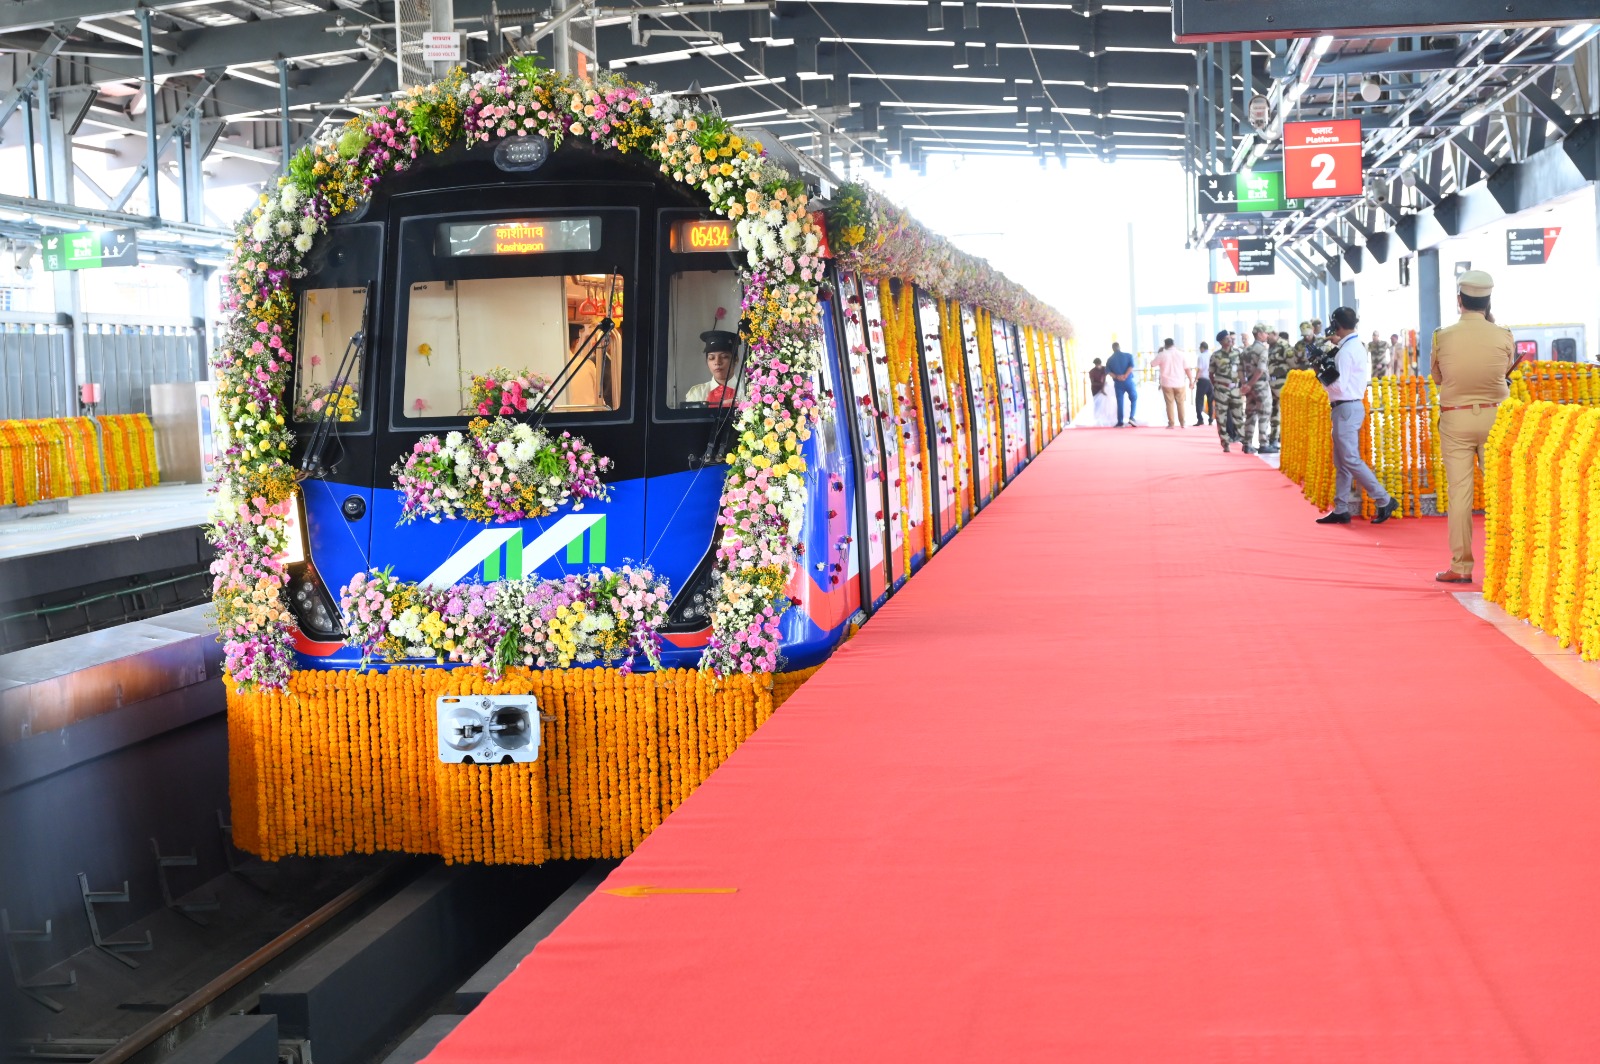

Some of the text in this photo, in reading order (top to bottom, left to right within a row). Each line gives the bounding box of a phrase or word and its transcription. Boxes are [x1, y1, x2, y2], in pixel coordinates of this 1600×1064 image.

[1311, 126, 1333, 135] फलाट
[1305, 136, 1339, 144] Platform
[1310, 153, 1337, 190] 2
[1247, 189, 1267, 199] Exit
[496, 224, 544, 239] काशीगाव
[691, 225, 729, 247] 05434
[496, 242, 544, 253] Kashigaon
[1214, 281, 1248, 293] 12:10
